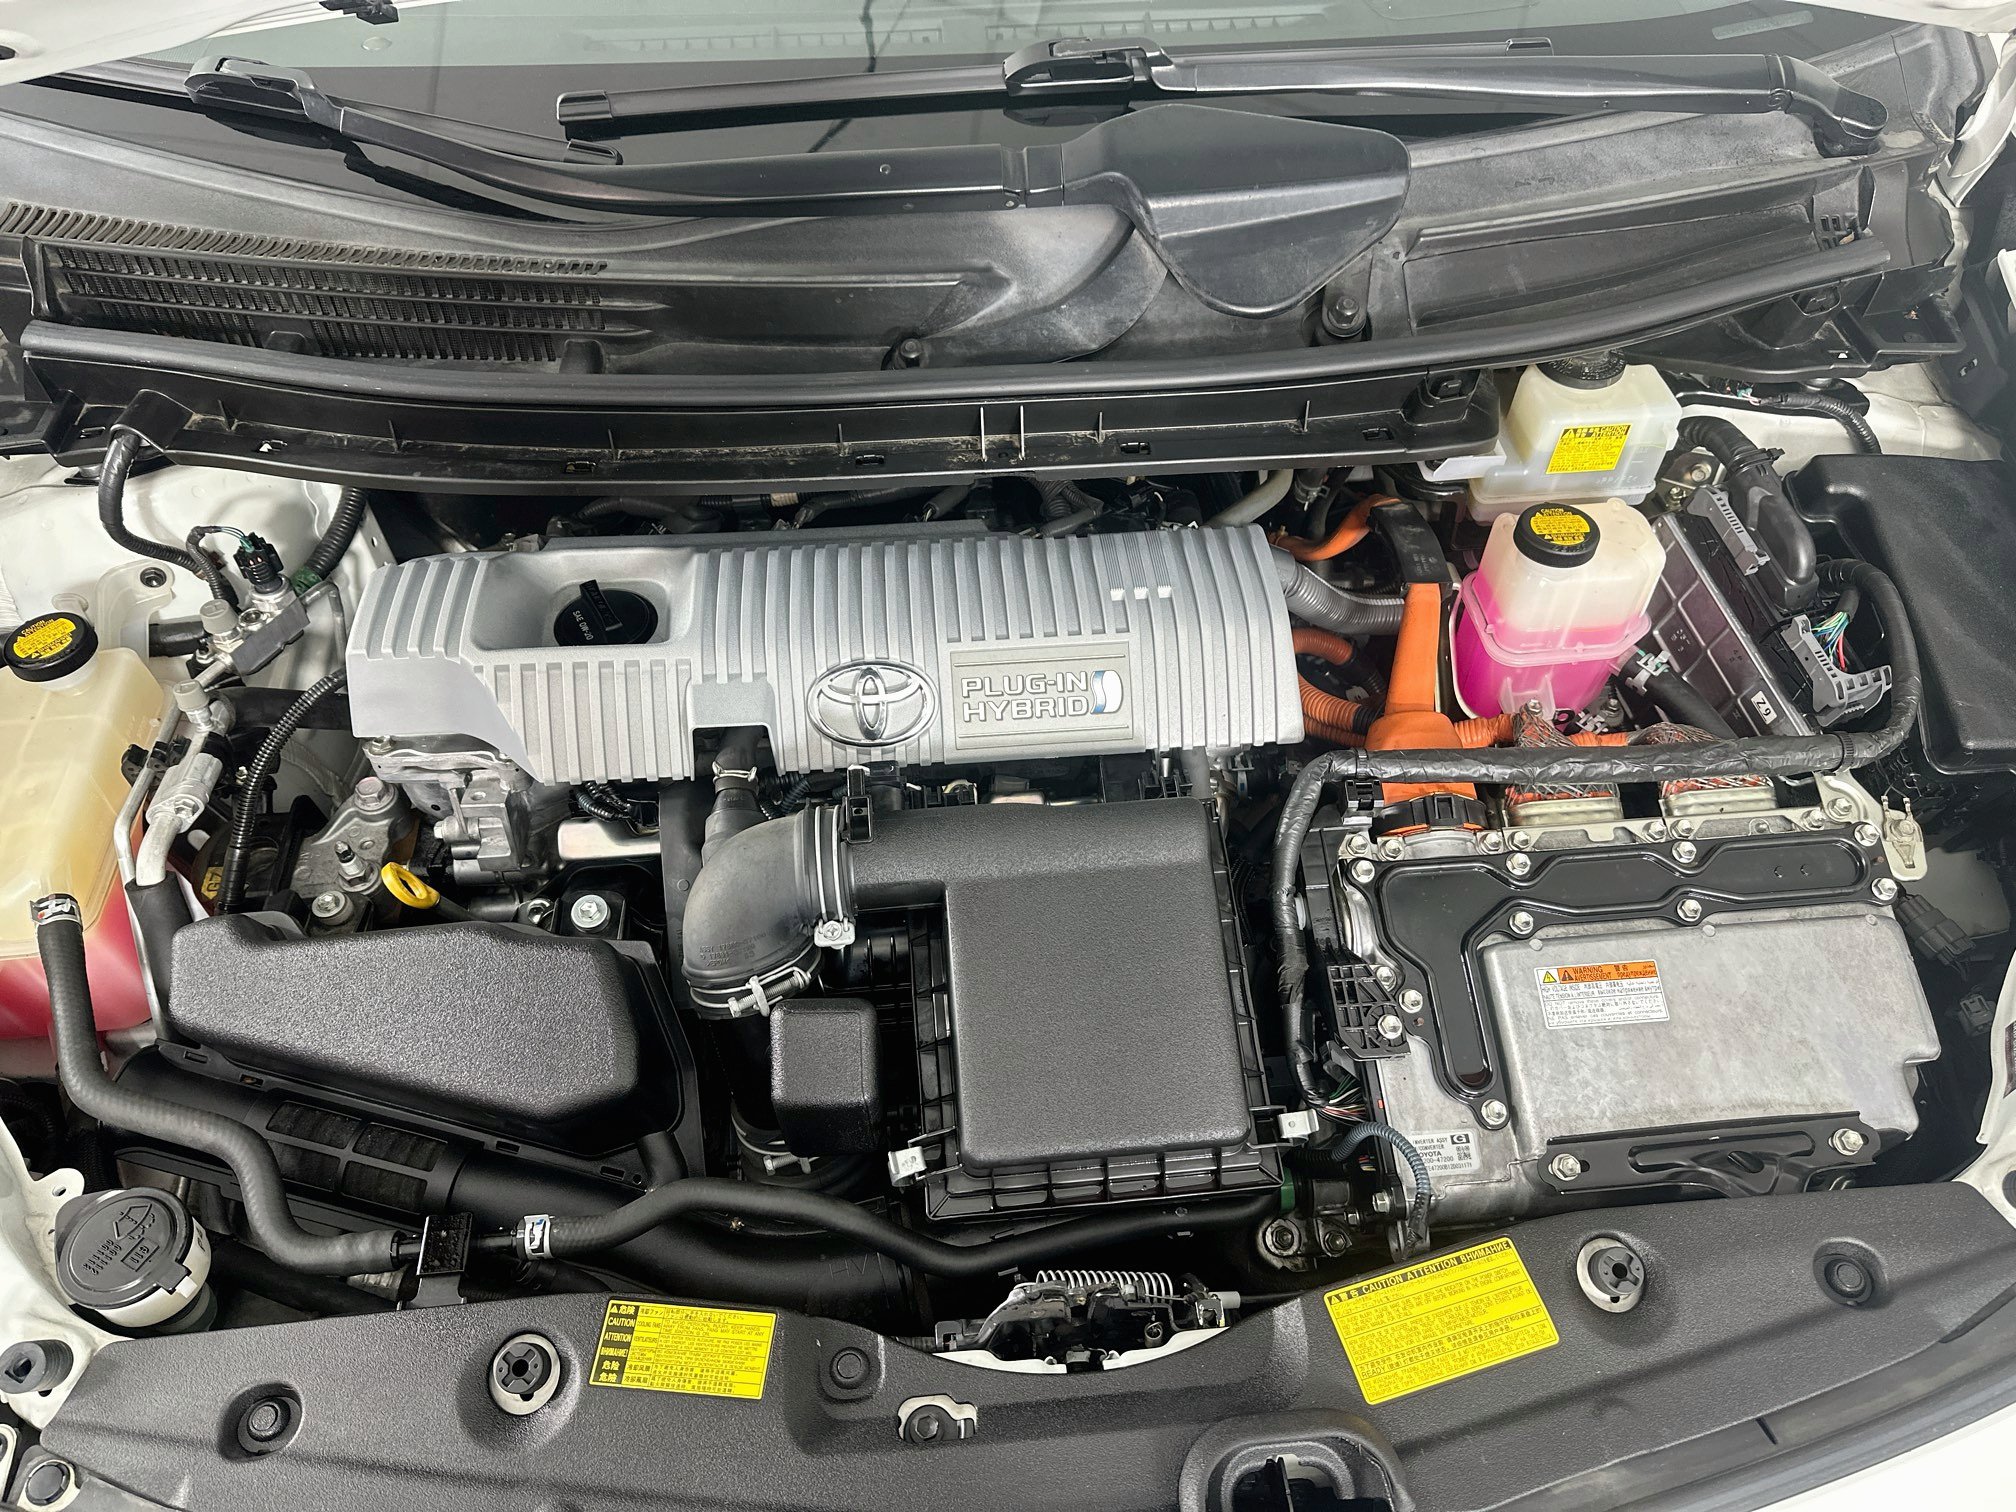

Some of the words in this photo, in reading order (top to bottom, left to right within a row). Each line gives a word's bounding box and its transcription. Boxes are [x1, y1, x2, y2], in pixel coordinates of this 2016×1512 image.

[572, 609, 584, 623] SAE
[579, 620, 595, 641] 0W-20
[961, 671, 1088, 698] PLUG-IN
[962, 696, 1089, 722] HYBRID
[1756, 697, 1772, 717] Z9
[1572, 966, 1603, 975] WARNING
[1419, 1150, 1442, 1158] OYOTA
[1424, 1156, 1454, 1164] 200-47200
[1361, 1274, 1404, 1294] CAUTION
[1406, 1258, 1459, 1280] ATTENTION
[1459, 1242, 1510, 1263] ВНИМАНИЕ
[618, 1305, 636, 1315] 危険
[607, 1317, 636, 1327] CAUTION
[604, 1332, 632, 1342] ATTENTION
[1361, 1366, 1386, 1378] READY
